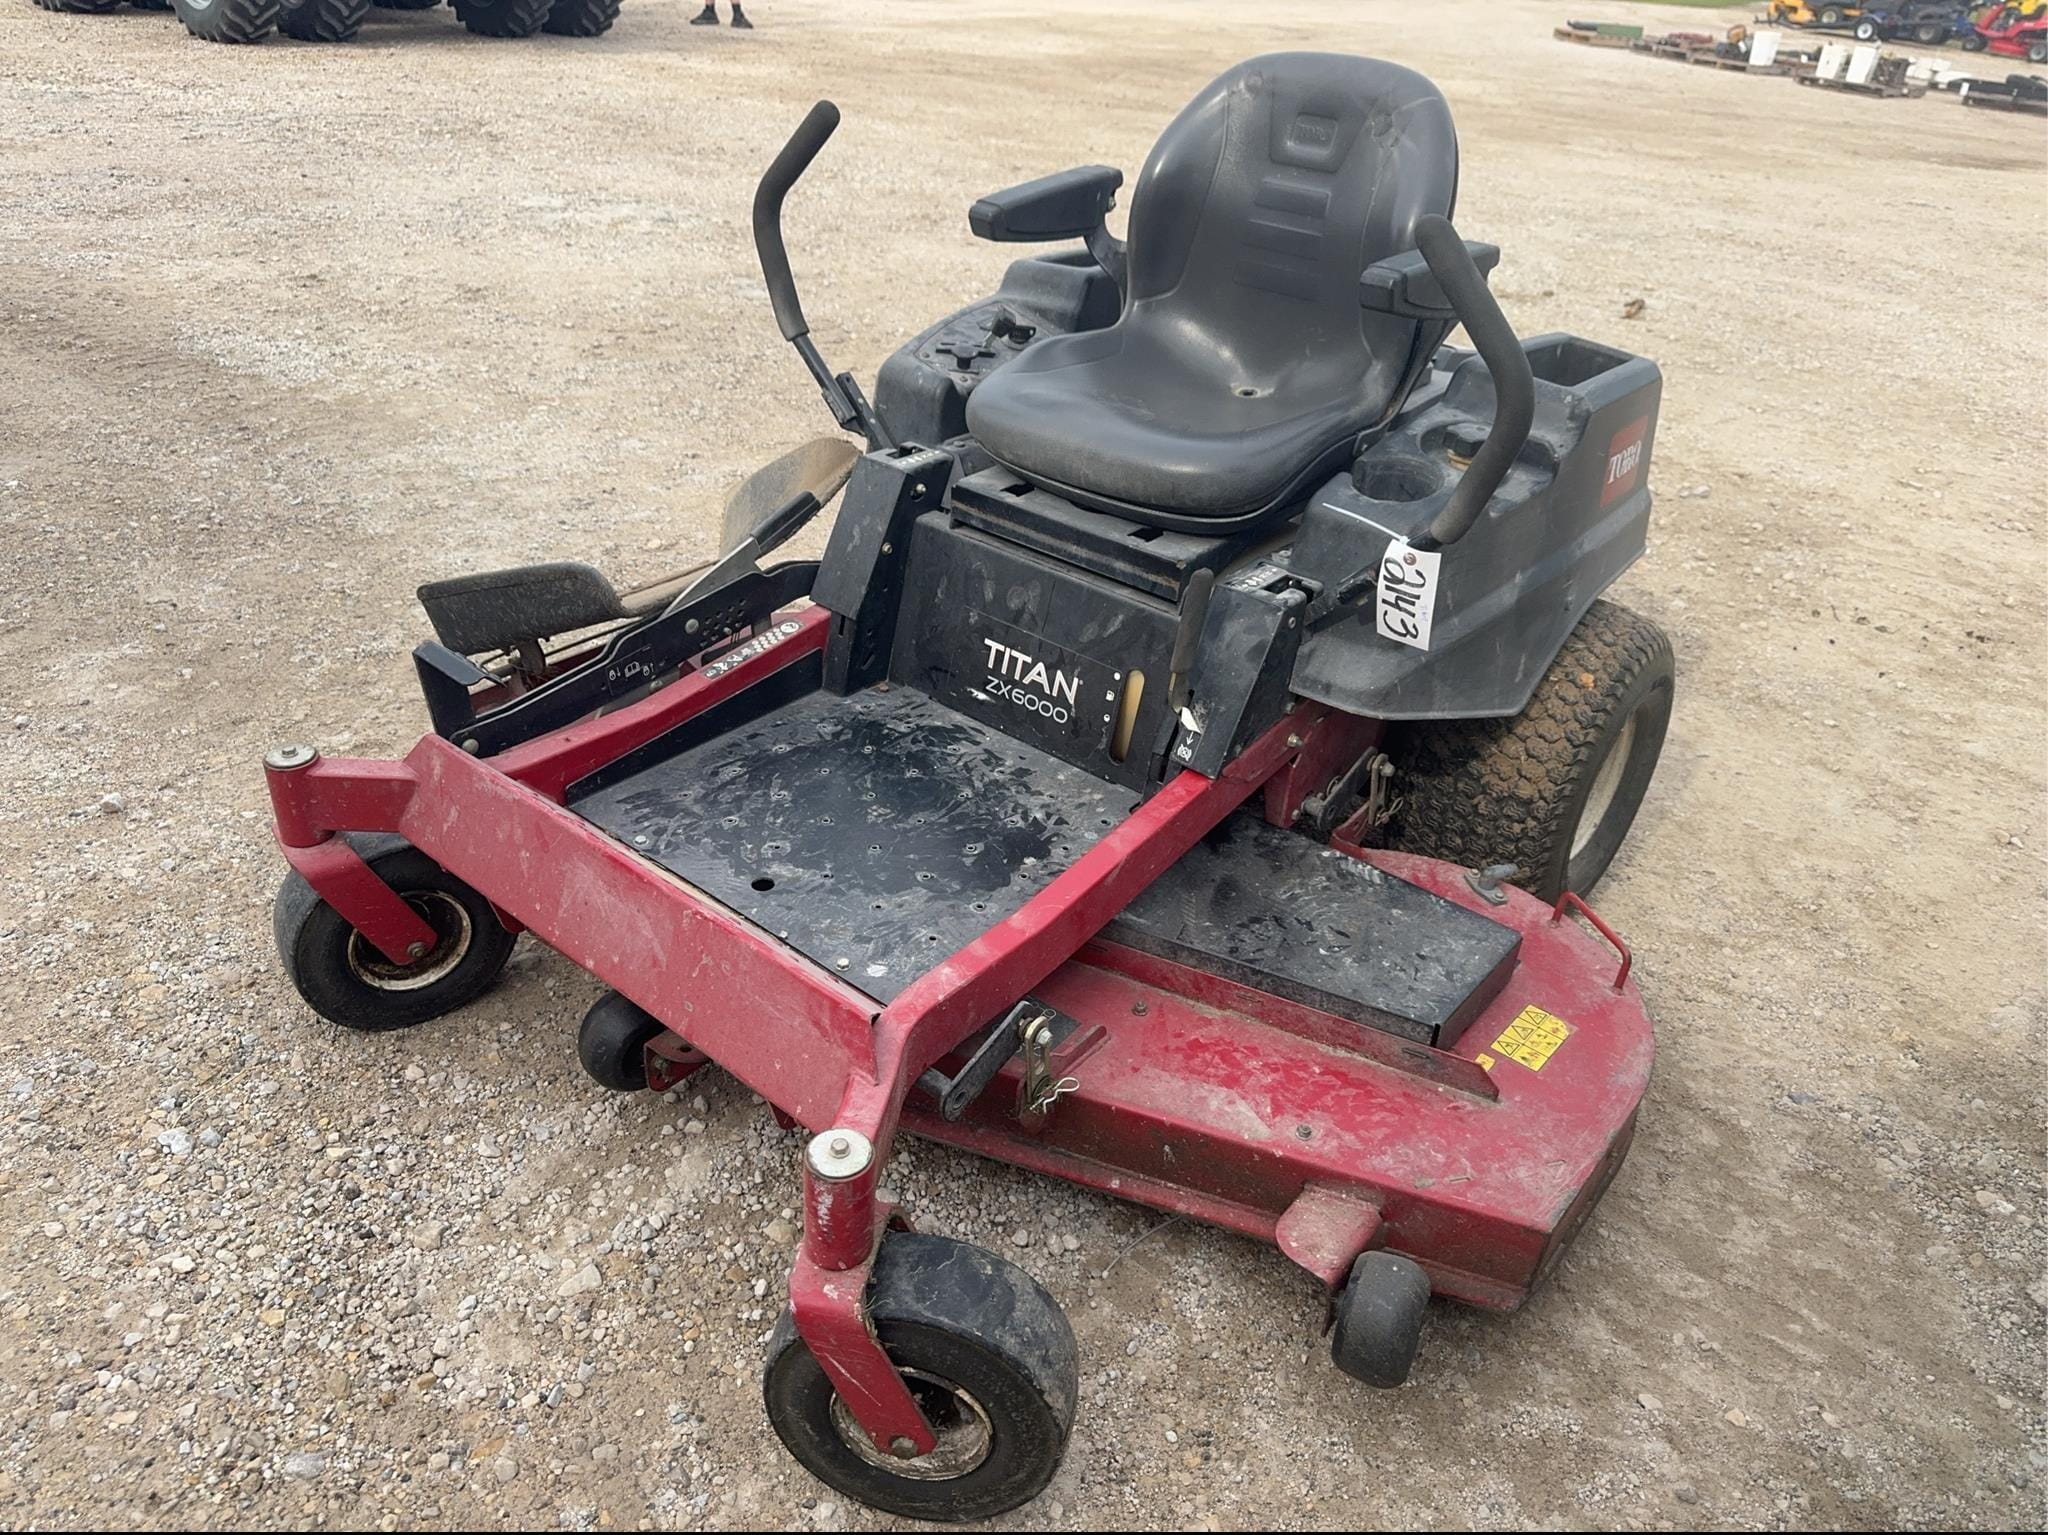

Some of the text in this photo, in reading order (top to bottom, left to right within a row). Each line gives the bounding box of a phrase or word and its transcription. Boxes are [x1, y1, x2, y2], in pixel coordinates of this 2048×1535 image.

[1607, 440, 1642, 484] TORO
[1382, 556, 1426, 639] 2143
[984, 638, 1080, 705] TITAN
[985, 675, 1069, 724] ZX6000
